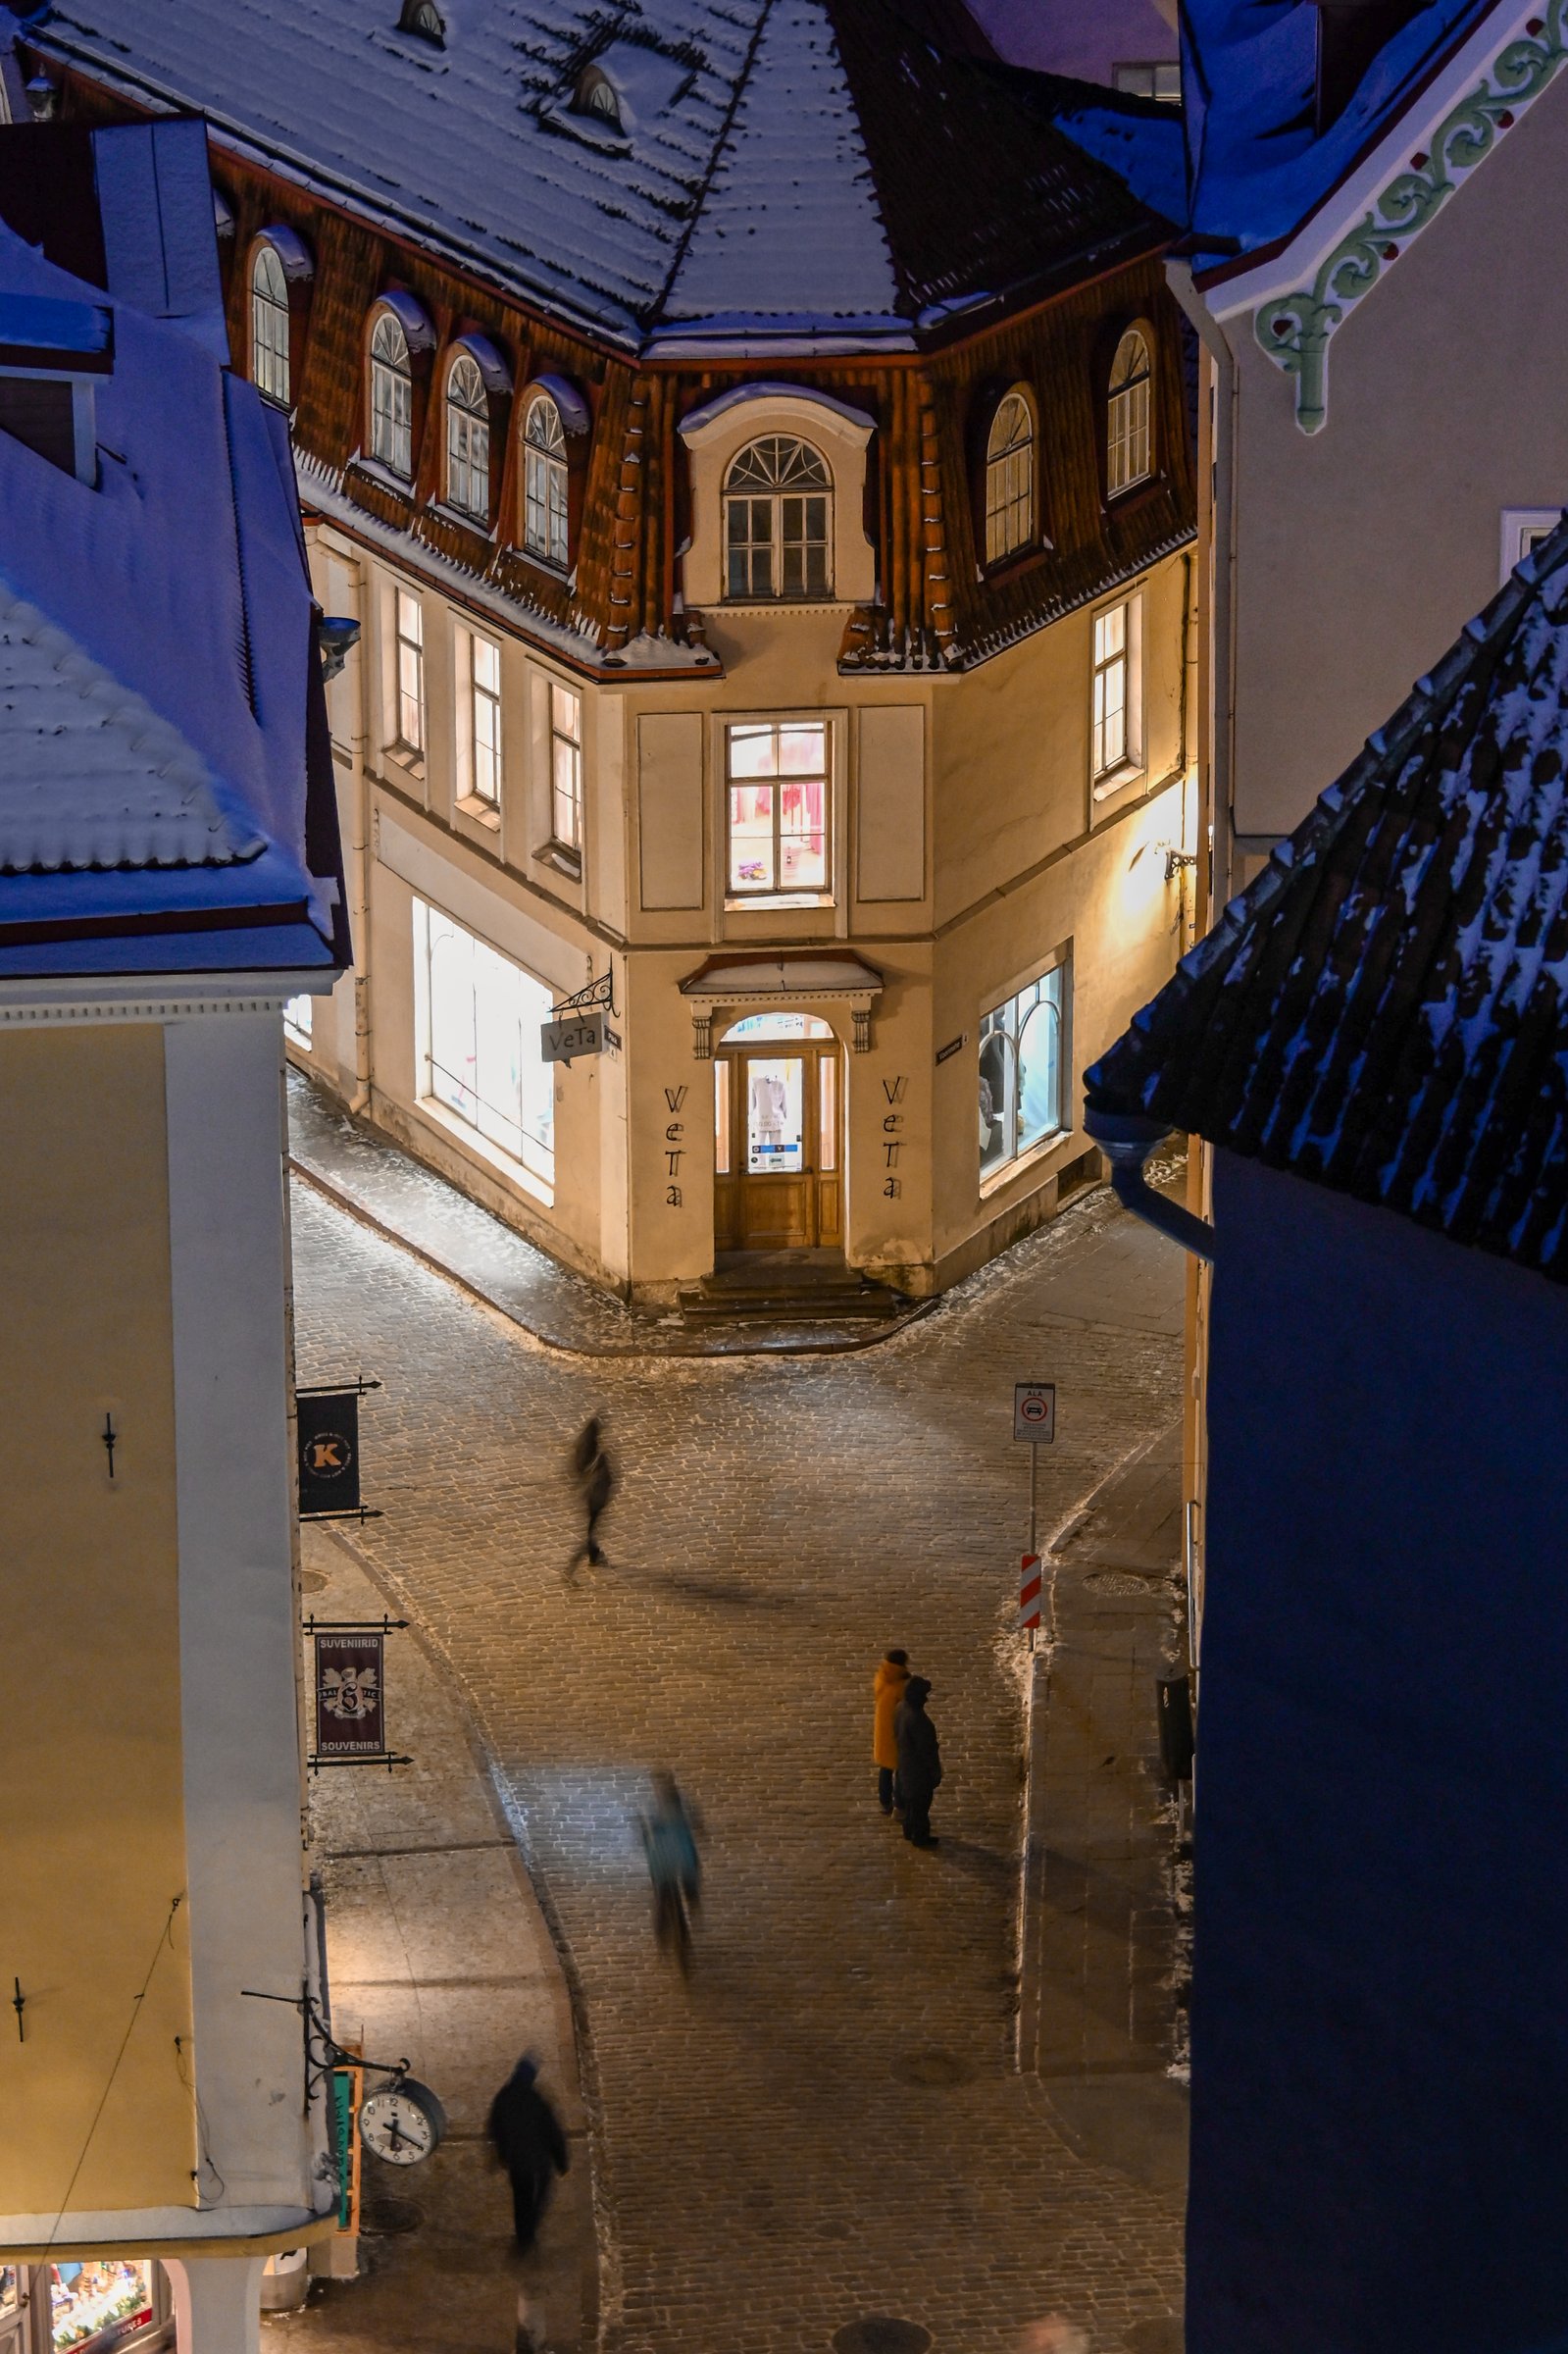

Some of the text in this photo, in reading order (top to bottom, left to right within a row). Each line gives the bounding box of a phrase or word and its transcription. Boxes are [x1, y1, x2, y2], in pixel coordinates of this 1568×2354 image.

[549, 1027, 595, 1051] VeTa
[883, 1076, 904, 1199] VeTa
[665, 1085, 687, 1207] VeTa
[313, 1444, 341, 1468] K
[320, 1639, 379, 1648] SUVENIIRID
[321, 1741, 380, 1751] SOUVENIRS
[389, 2098, 398, 2107] 12
[417, 2117, 423, 2125] 2
[422, 2130, 428, 2139] 3
[379, 2144, 385, 2154] 7
[409, 2151, 415, 2160] 5
